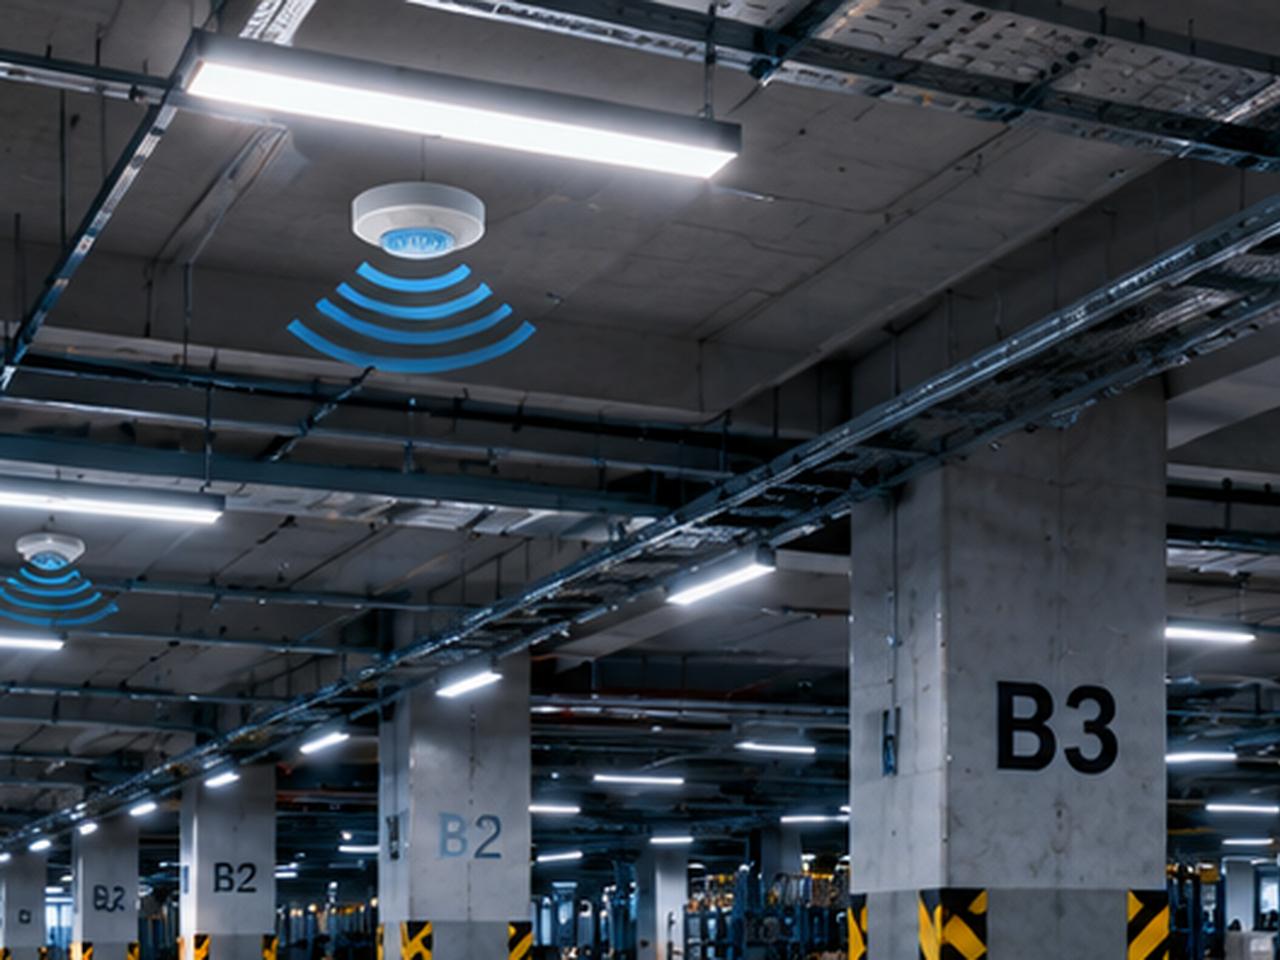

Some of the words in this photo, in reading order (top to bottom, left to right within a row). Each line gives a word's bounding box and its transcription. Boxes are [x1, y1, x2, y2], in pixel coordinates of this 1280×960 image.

[996, 680, 1118, 775] B3
[439, 811, 502, 859] B2
[213, 861, 258, 893] B2
